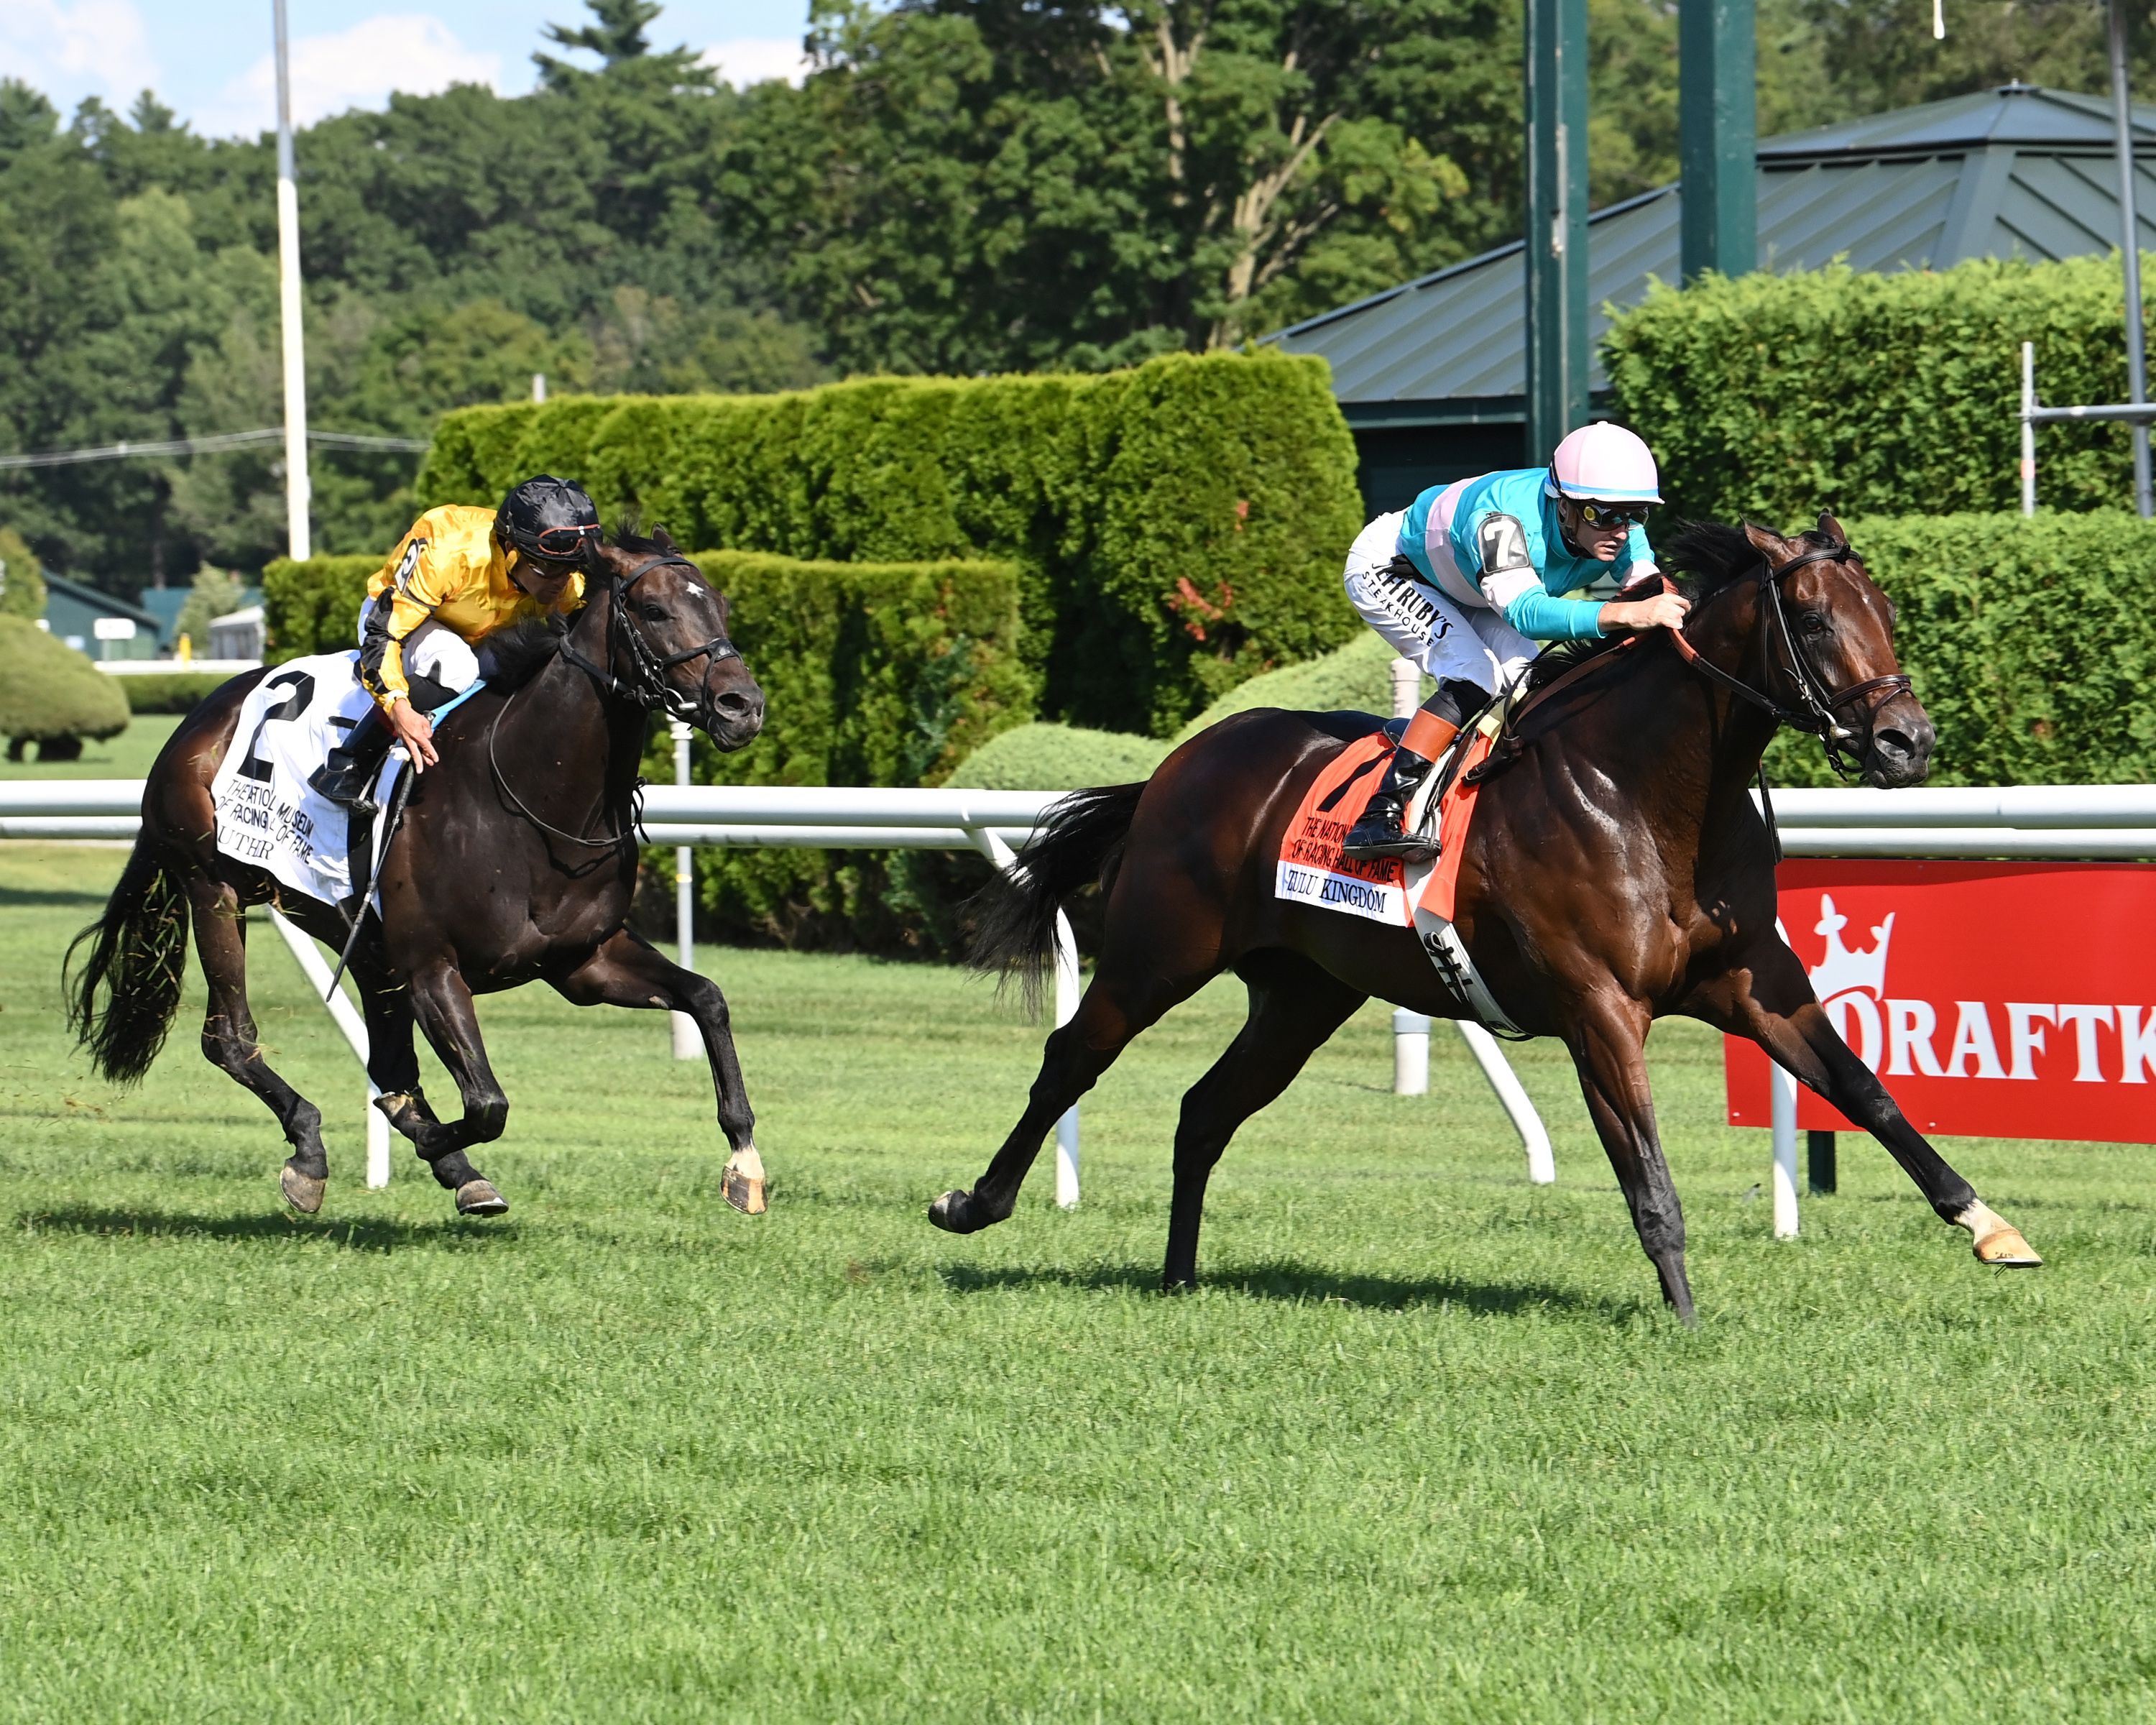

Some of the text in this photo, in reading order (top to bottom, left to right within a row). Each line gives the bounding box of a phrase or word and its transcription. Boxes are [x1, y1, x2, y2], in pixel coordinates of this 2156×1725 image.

[395, 544, 418, 592] 2
[1483, 520, 1517, 568] 7
[1362, 571, 1434, 647] STEAKHOUSE
[1396, 586, 1454, 639] RUBY'S
[236, 670, 315, 783] 2
[227, 779, 249, 800] THE
[216, 796, 233, 811] OF
[230, 804, 269, 829] RACING
[276, 825, 295, 845] OF
[289, 835, 313, 865] FAME
[1302, 816, 1322, 838] THE
[1291, 839, 1307, 859] OF
[1303, 842, 1335, 868] RACING
[1368, 859, 1399, 883] FAME
[1287, 870, 1388, 914] ZULU KINGDOM
